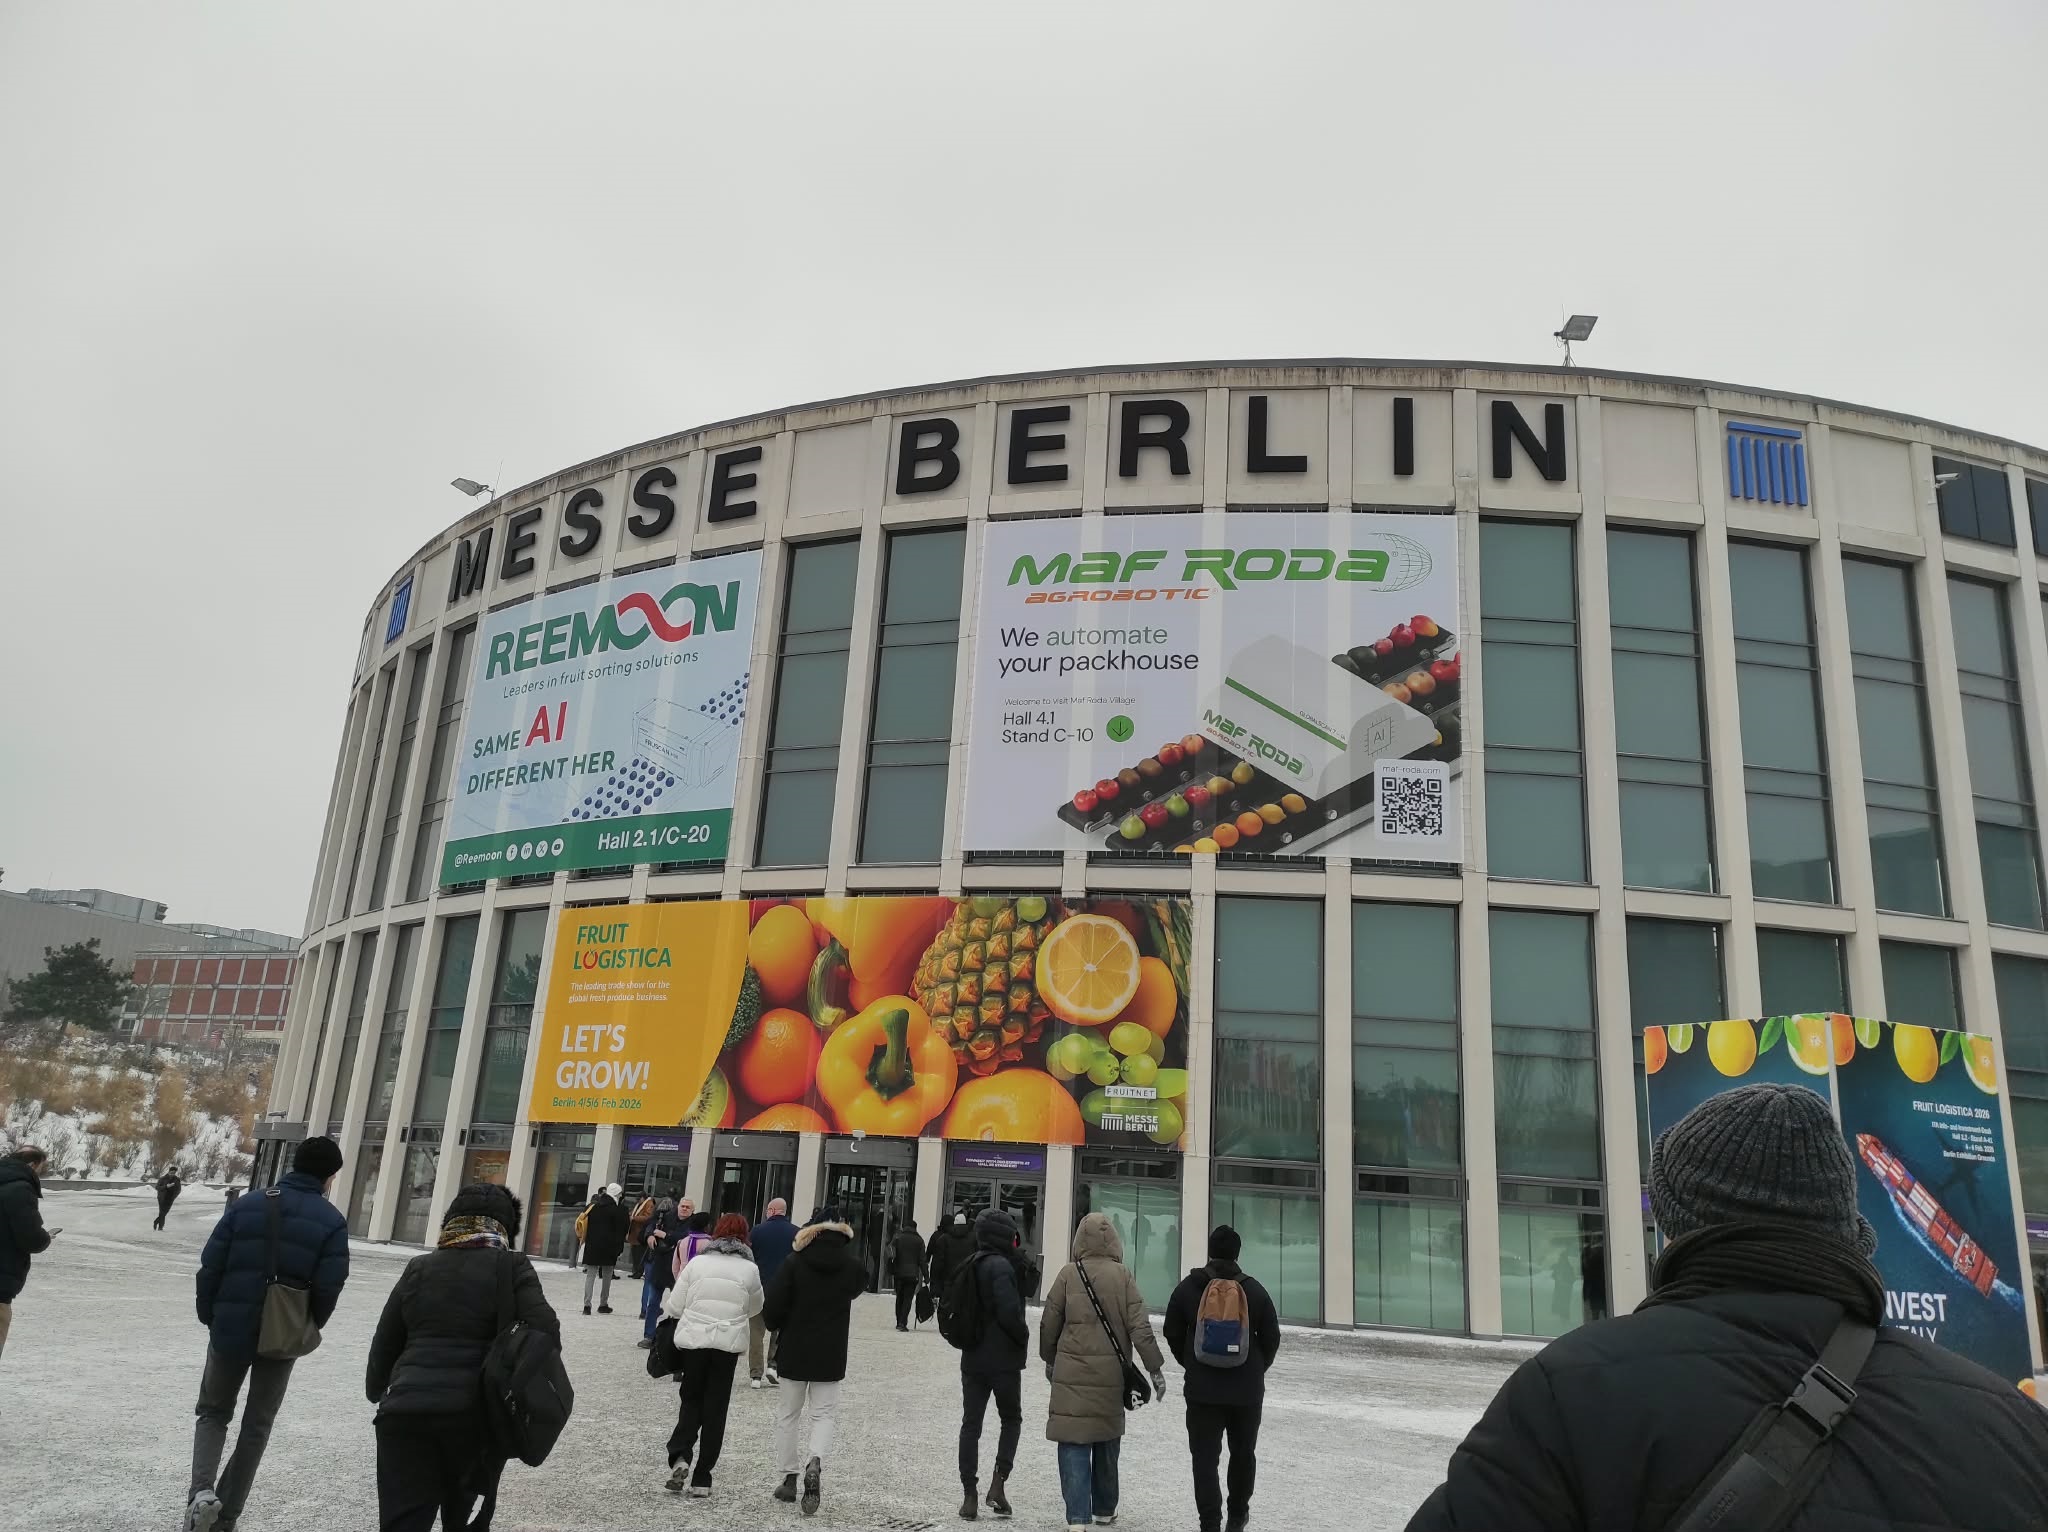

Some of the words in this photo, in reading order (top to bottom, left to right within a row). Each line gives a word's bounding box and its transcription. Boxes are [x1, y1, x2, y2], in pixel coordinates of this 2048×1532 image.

[448, 446, 762, 603] MESSE
[895, 396, 1568, 495] BERLIN
[485, 581, 741, 680] REEMOON
[1001, 627, 1039, 647] We
[1046, 626, 1168, 646] automate
[999, 655, 1052, 679] your
[1059, 649, 1199, 677] packhouse
[503, 678, 544, 699] Leaders
[547, 674, 557, 688] in
[560, 668, 585, 686] fruit
[587, 661, 632, 680] sorting
[635, 651, 699, 671] solutions
[1003, 711, 1031, 726] Hall
[1036, 711, 1055, 725] 4.1
[473, 730, 521, 759] SAME
[525, 701, 568, 747] AI
[1001, 728, 1048, 744] Stand
[1054, 728, 1094, 743] C-10
[1374, 728, 1385, 744] AI
[466, 756, 569, 795] DIFFERENT
[571, 750, 615, 776] HER
[598, 830, 630, 852] Hall
[633, 824, 711, 848] 2.1/C-20
[454, 849, 502, 868] @Reemoon
[577, 923, 629, 945] FRUIT
[573, 947, 672, 970] LOGISTICA
[571, 982, 583, 991] The
[584, 981, 607, 992] leading
[608, 981, 625, 990] trade
[626, 980, 645, 990] show
[647, 980, 657, 990] for
[658, 980, 670, 989] the
[607, 994, 635, 1003] produce
[561, 1023, 627, 1053] LET'S
[556, 1060, 650, 1090] GROW!
[552, 1096, 576, 1108] Berlin
[601, 1097, 617, 1108] Feb
[619, 1098, 642, 1109] 2026
[1106, 1088, 1155, 1097] FRUITNET
[1125, 1114, 1158, 1123] MESSE
[1913, 1101, 1934, 1112] FRUIT
[1935, 1103, 1973, 1117] LOGISTICA
[1125, 1123, 1158, 1132] BERLIN
